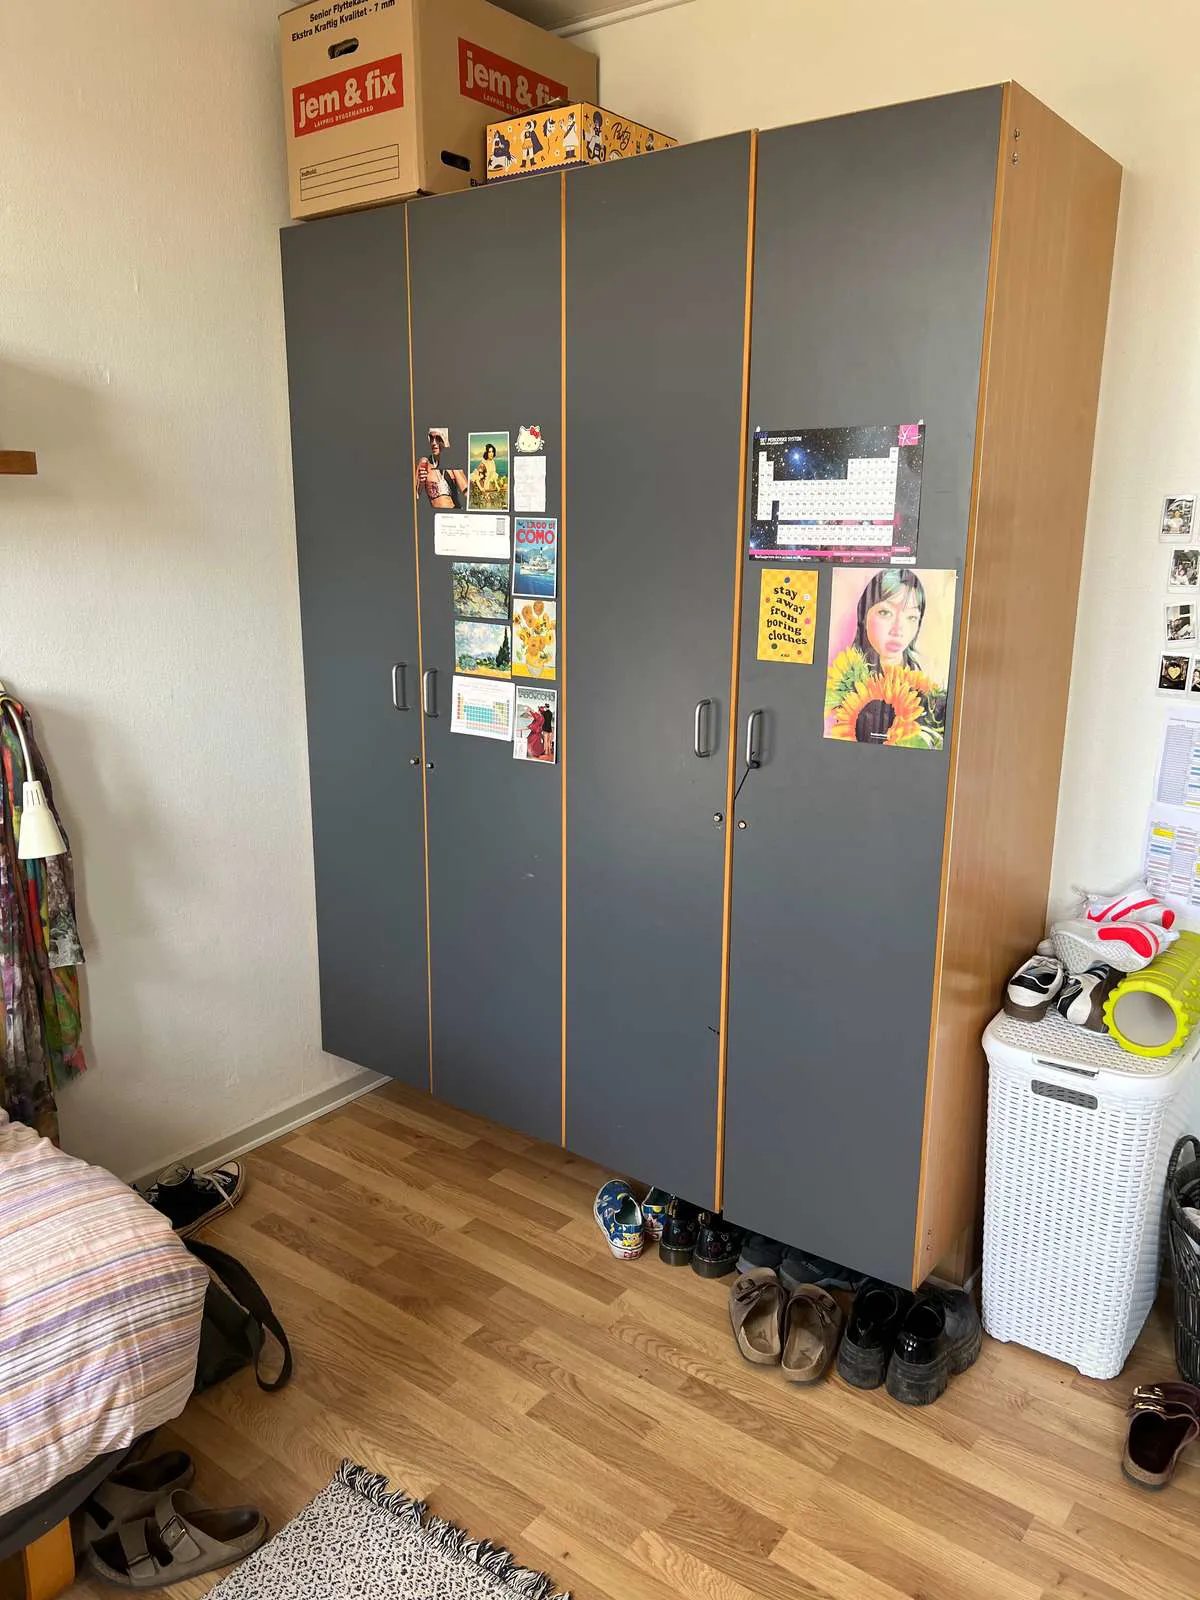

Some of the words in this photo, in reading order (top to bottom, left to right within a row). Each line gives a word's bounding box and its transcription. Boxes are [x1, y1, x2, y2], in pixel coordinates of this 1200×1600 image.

[291, 28, 313, 41] Ekstra
[314, 18, 338, 34] Kraftig
[340, 7, 368, 24] Kvalitet
[374, 3, 379, 11] 7
[381, 0, 395, 10] mm
[309, 8, 332, 22] Senior
[466, 50, 512, 99] jem
[516, 74, 533, 108] &
[535, 82, 559, 107] fi
[299, 91, 340, 128] jem
[344, 78, 363, 107] &
[365, 69, 397, 101] fix
[527, 521, 547, 529] LAGO
[516, 529, 555, 544] COMO
[773, 586, 798, 600] stay
[770, 606, 798, 623] from
[776, 597, 805, 615] away
[767, 618, 802, 636] boring
[768, 630, 808, 645] clothes
